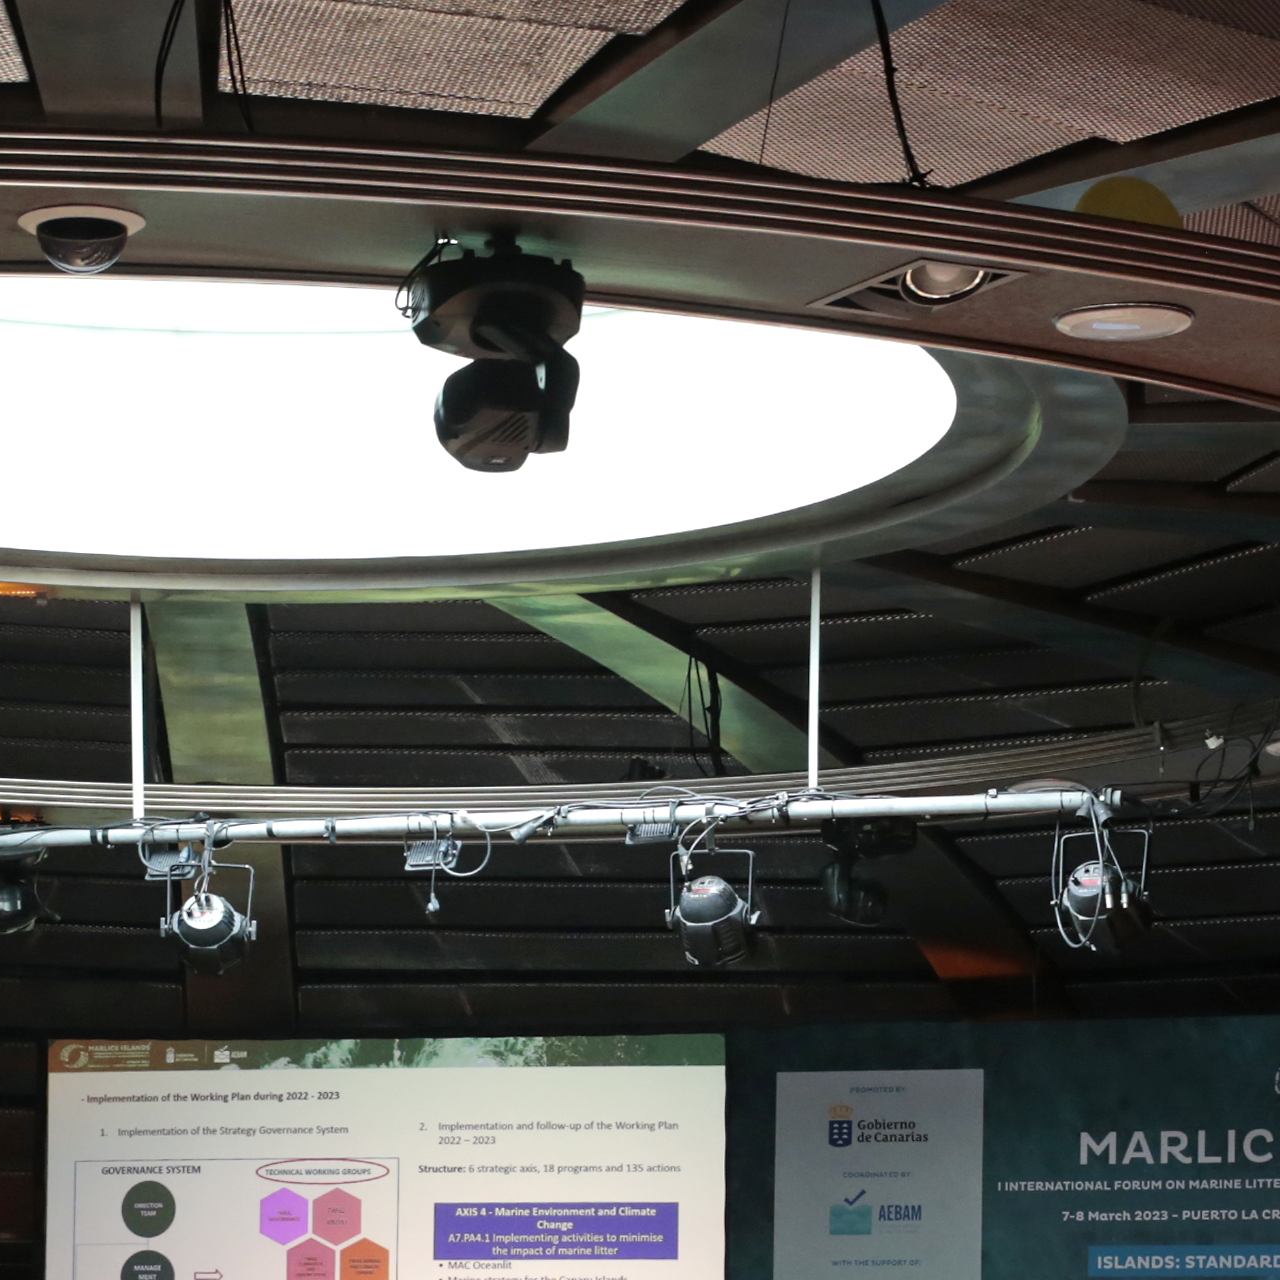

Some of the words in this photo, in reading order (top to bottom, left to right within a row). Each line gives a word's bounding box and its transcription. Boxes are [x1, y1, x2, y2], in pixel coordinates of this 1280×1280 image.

[87, 1094, 159, 1105] Implementation
[161, 1093, 171, 1102] of
[173, 1093, 188, 1102] the
[190, 1092, 229, 1103] Working
[231, 1092, 251, 1101] Plan
[253, 1092, 284, 1103] during
[286, 1091, 309, 1100] 2022
[317, 1091, 340, 1100] 2023
[419, 1123, 427, 1131] 2.
[438, 1122, 513, 1133] Implementation
[516, 1122, 534, 1130] and
[536, 1121, 582, 1133] follow-up
[584, 1121, 594, 1130] of
[597, 1121, 613, 1130] the
[615, 1121, 656, 1132] Working
[658, 1121, 679, 1130] Plan
[857, 1120, 916, 1130] Gobierno
[100, 1128, 108, 1137] 1.
[118, 1127, 189, 1138] Implementation
[190, 1126, 201, 1136] of
[202, 1126, 218, 1135] the
[219, 1126, 257, 1137] Strategy
[258, 1125, 314, 1135] Governance
[315, 1125, 349, 1136] System
[857, 1132, 872, 1142] de
[874, 1132, 929, 1142] Canarias
[438, 1136, 461, 1145] 2022
[473, 1136, 496, 1145] 2023
[102, 1166, 163, 1175] GOVERNANCE
[166, 1165, 201, 1174] SYSTEM
[418, 1164, 466, 1173] Structure:
[468, 1165, 474, 1173] 6
[477, 1164, 517, 1175] strategic
[520, 1164, 540, 1174] axis,
[543, 1164, 555, 1173] 18
[557, 1165, 603, 1175] programs
[605, 1164, 623, 1172] and
[626, 1164, 644, 1172] 135
[646, 1164, 681, 1172] actions
[1005, 1181, 1111, 1191] INTERNATIONAL
[1114, 1180, 1162, 1190] FORUM
[1166, 1180, 1186, 1190] ON
[1189, 1179, 1242, 1190] MARINE
[456, 1207, 478, 1216] AXIS
[480, 1208, 486, 1216] 4
[495, 1207, 530, 1216] Marine
[532, 1207, 595, 1216] Environment
[598, 1207, 616, 1216] and
[619, 1207, 656, 1216] Climate
[878, 1205, 922, 1221] AEBAM
[1062, 1211, 1085, 1222] 7-8
[1088, 1210, 1131, 1222] March
[1134, 1210, 1169, 1221] 2023
[1182, 1209, 1238, 1220] PUERTO
[1241, 1209, 1259, 1220] LA
[537, 1220, 573, 1231] Change
[493, 1233, 559, 1245] Implementing
[561, 1233, 604, 1242] activities
[606, 1233, 616, 1242] to
[619, 1233, 663, 1242] minimise
[492, 1246, 508, 1255] the
[510, 1246, 542, 1257] impact
[544, 1246, 556, 1255] of
[558, 1246, 592, 1255] marine
[594, 1246, 618, 1255] litter
[447, 1261, 470, 1270] MAC
[473, 1260, 512, 1270] Oceanlit
[1097, 1255, 1180, 1269] ISLANDS:
